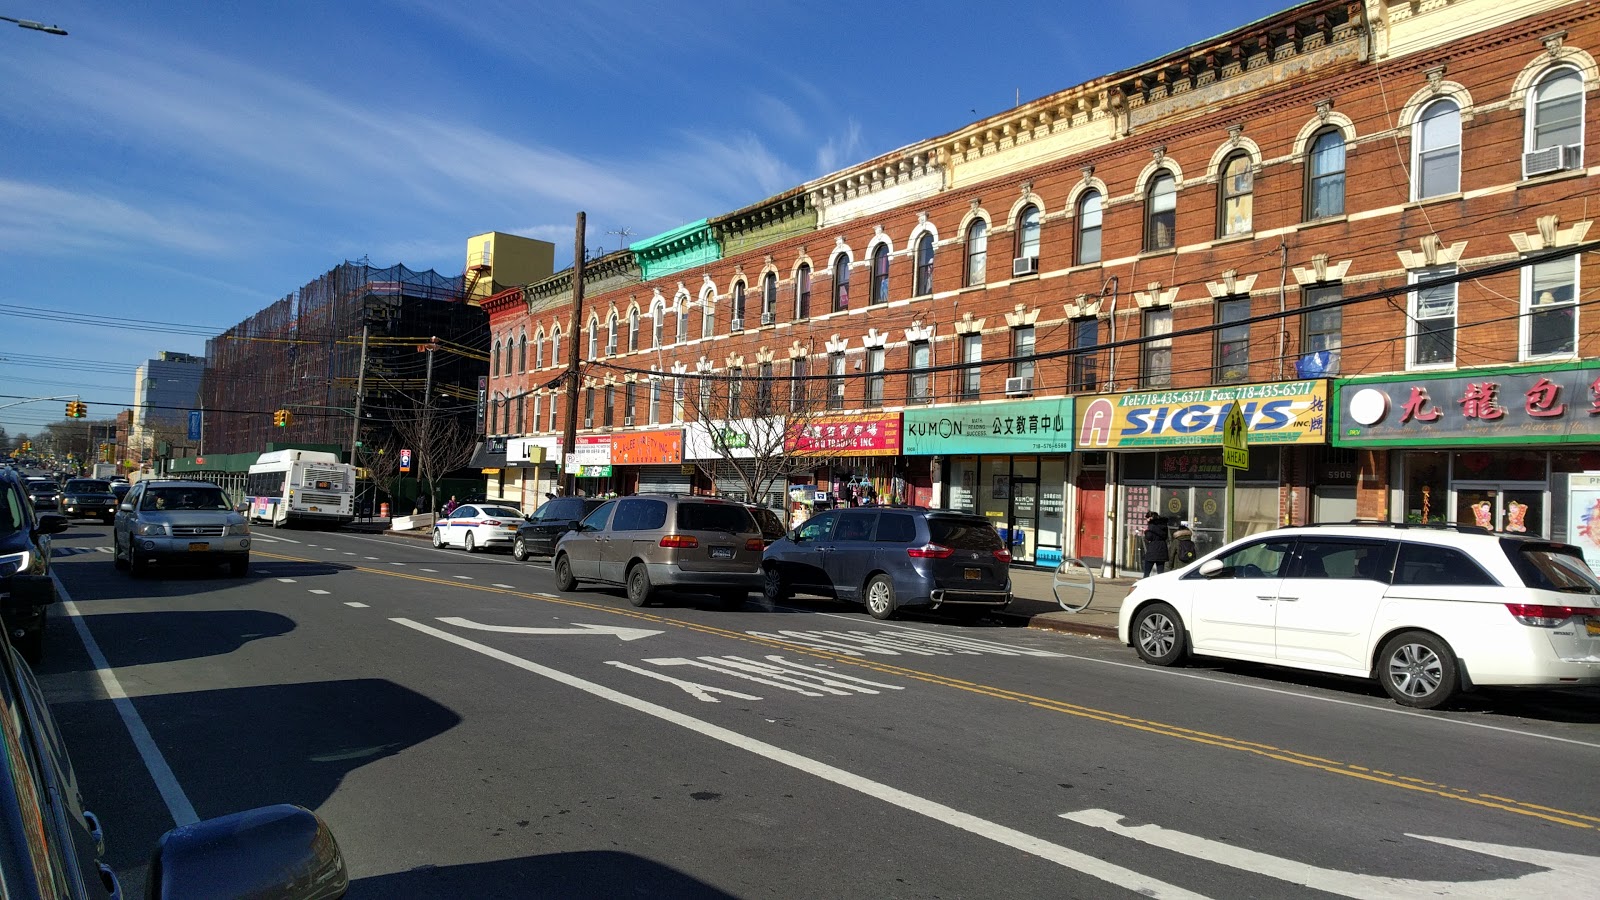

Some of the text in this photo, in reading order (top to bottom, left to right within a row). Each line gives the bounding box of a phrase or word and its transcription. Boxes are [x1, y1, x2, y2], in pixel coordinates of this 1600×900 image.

[1123, 382, 1311, 406] Tel:718-435-6371 Fax:718-435-6571
[908, 418, 962, 438] KUMON
[992, 414, 1064, 435] 公文教育中心
[1079, 398, 1311, 446] A SIGNS INC.
[828, 439, 857, 448] TRADING
[860, 438, 875, 446] INC.
[1227, 451, 1246, 465] AHEAD
[1328, 471, 1352, 479] 5906
